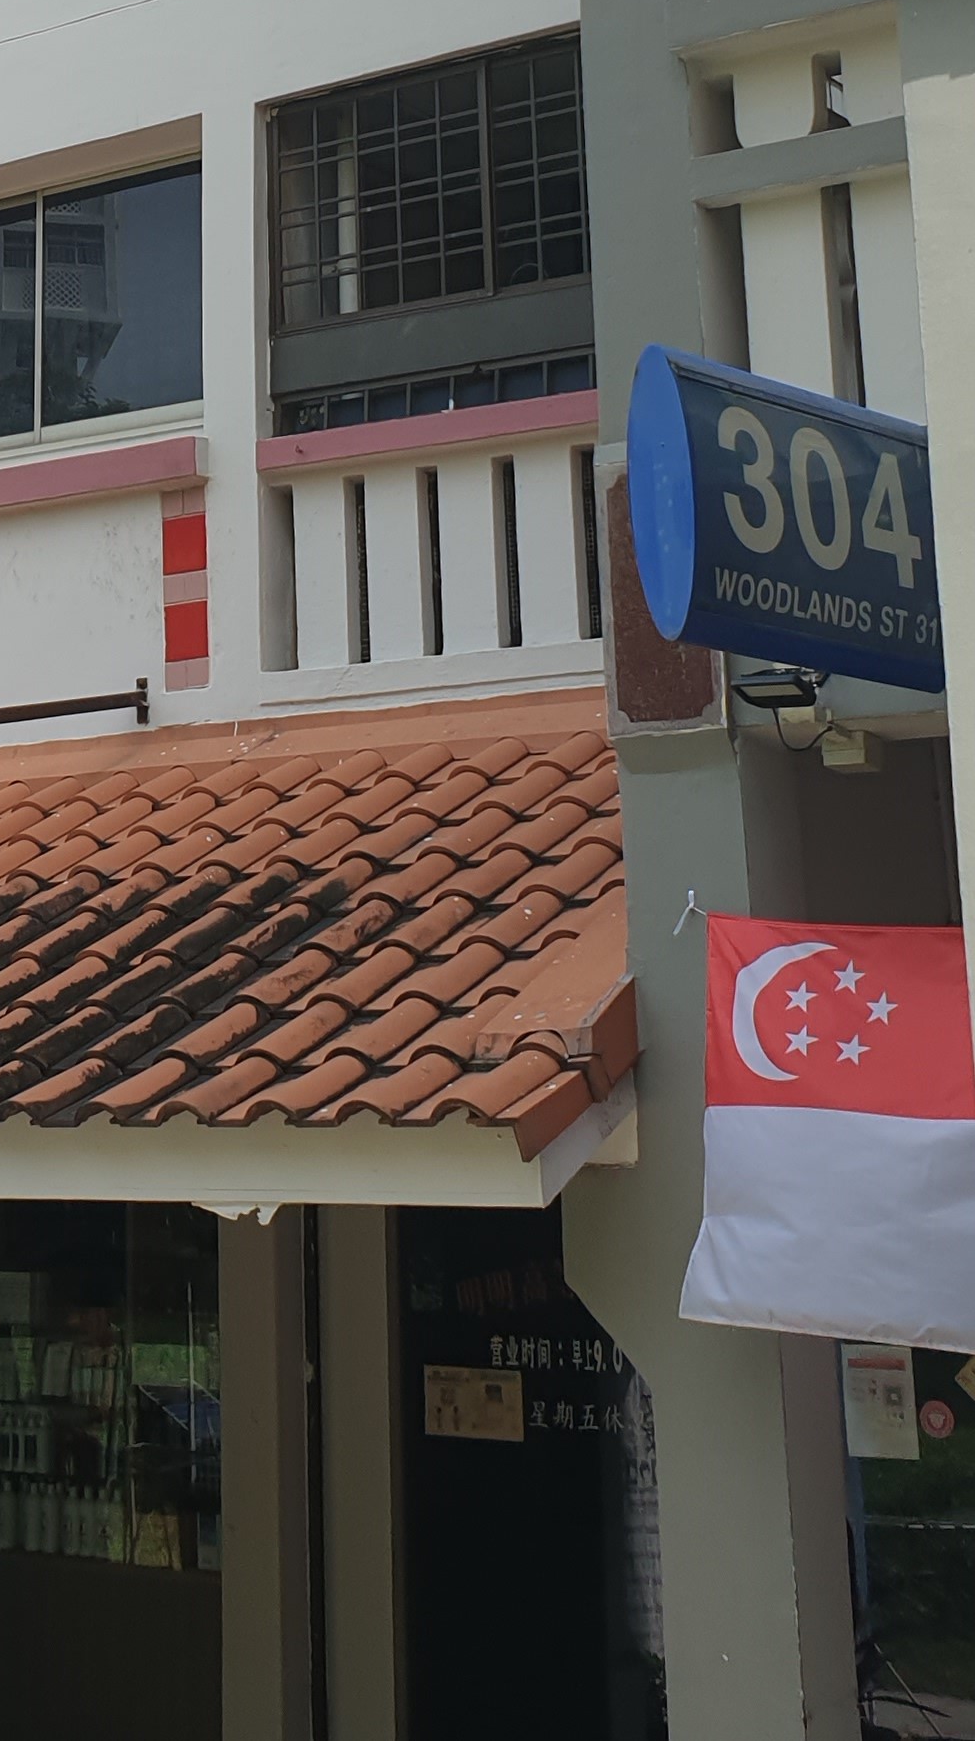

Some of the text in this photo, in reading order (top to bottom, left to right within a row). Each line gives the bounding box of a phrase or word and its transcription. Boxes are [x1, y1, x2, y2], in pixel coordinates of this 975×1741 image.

[717, 406, 923, 589] 304
[714, 567, 938, 647] WOODLANDS ST 31
